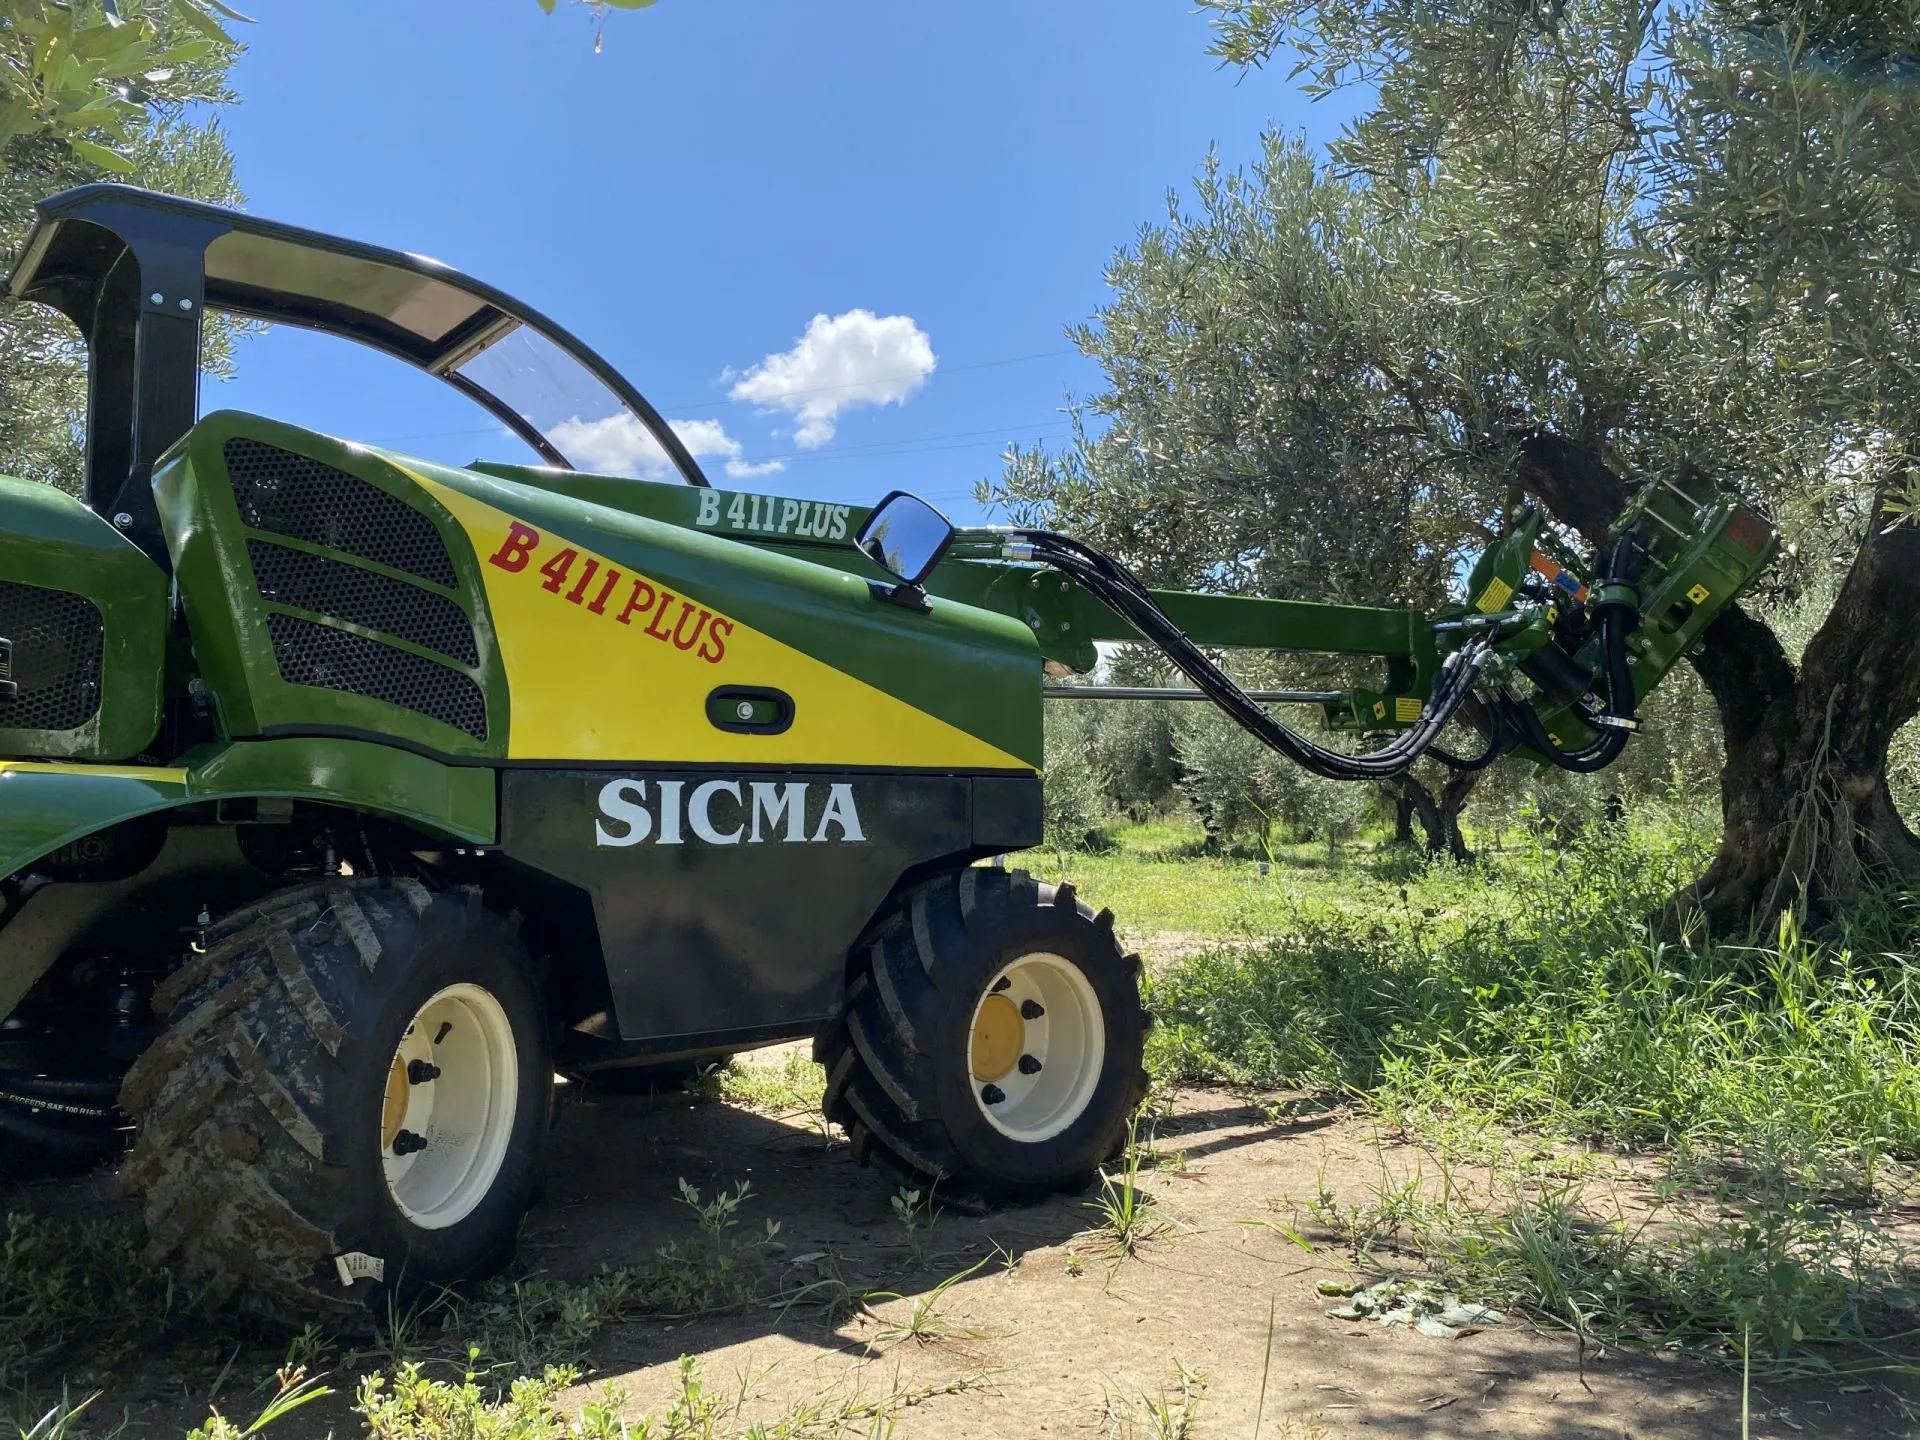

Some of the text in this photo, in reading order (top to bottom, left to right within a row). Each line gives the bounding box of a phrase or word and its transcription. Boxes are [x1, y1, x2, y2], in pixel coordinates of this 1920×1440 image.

[696, 489, 720, 527] B
[489, 521, 540, 573] B
[595, 778, 867, 847] SICMA
[9, 1094, 46, 1108] EXCEEDS
[47, 1102, 63, 1112] SAE
[65, 1106, 79, 1114] 100
